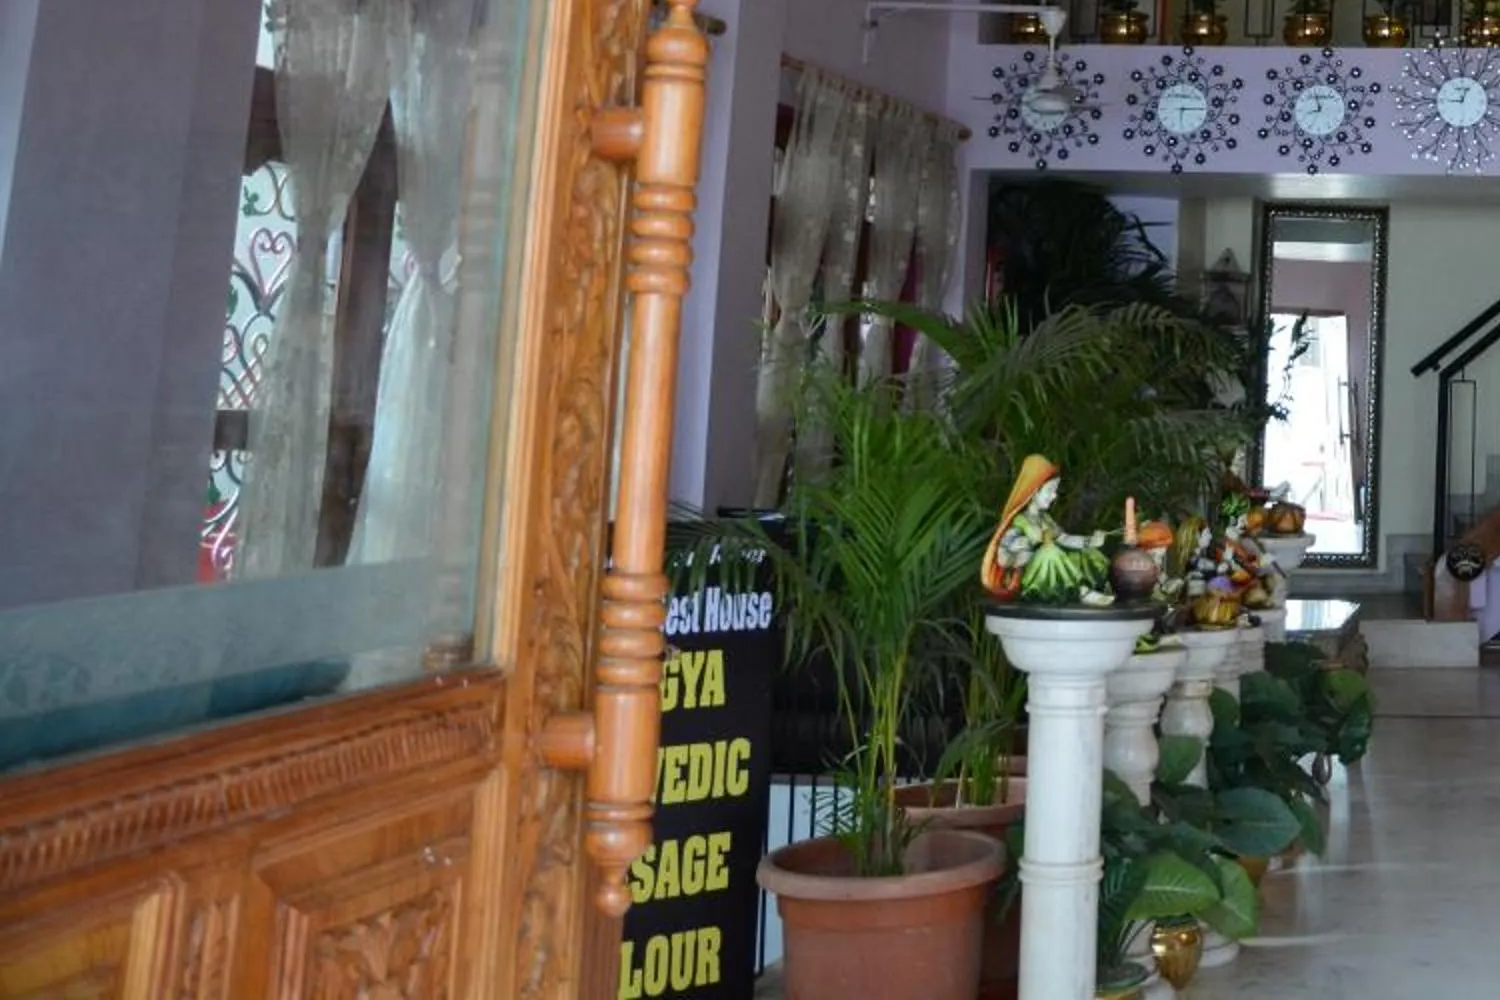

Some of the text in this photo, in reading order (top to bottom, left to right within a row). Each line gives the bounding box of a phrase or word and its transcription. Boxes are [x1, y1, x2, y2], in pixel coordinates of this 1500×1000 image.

[660, 587, 773, 635] est House
[625, 831, 732, 904] SAGE
[618, 925, 721, 1000] LOUR
